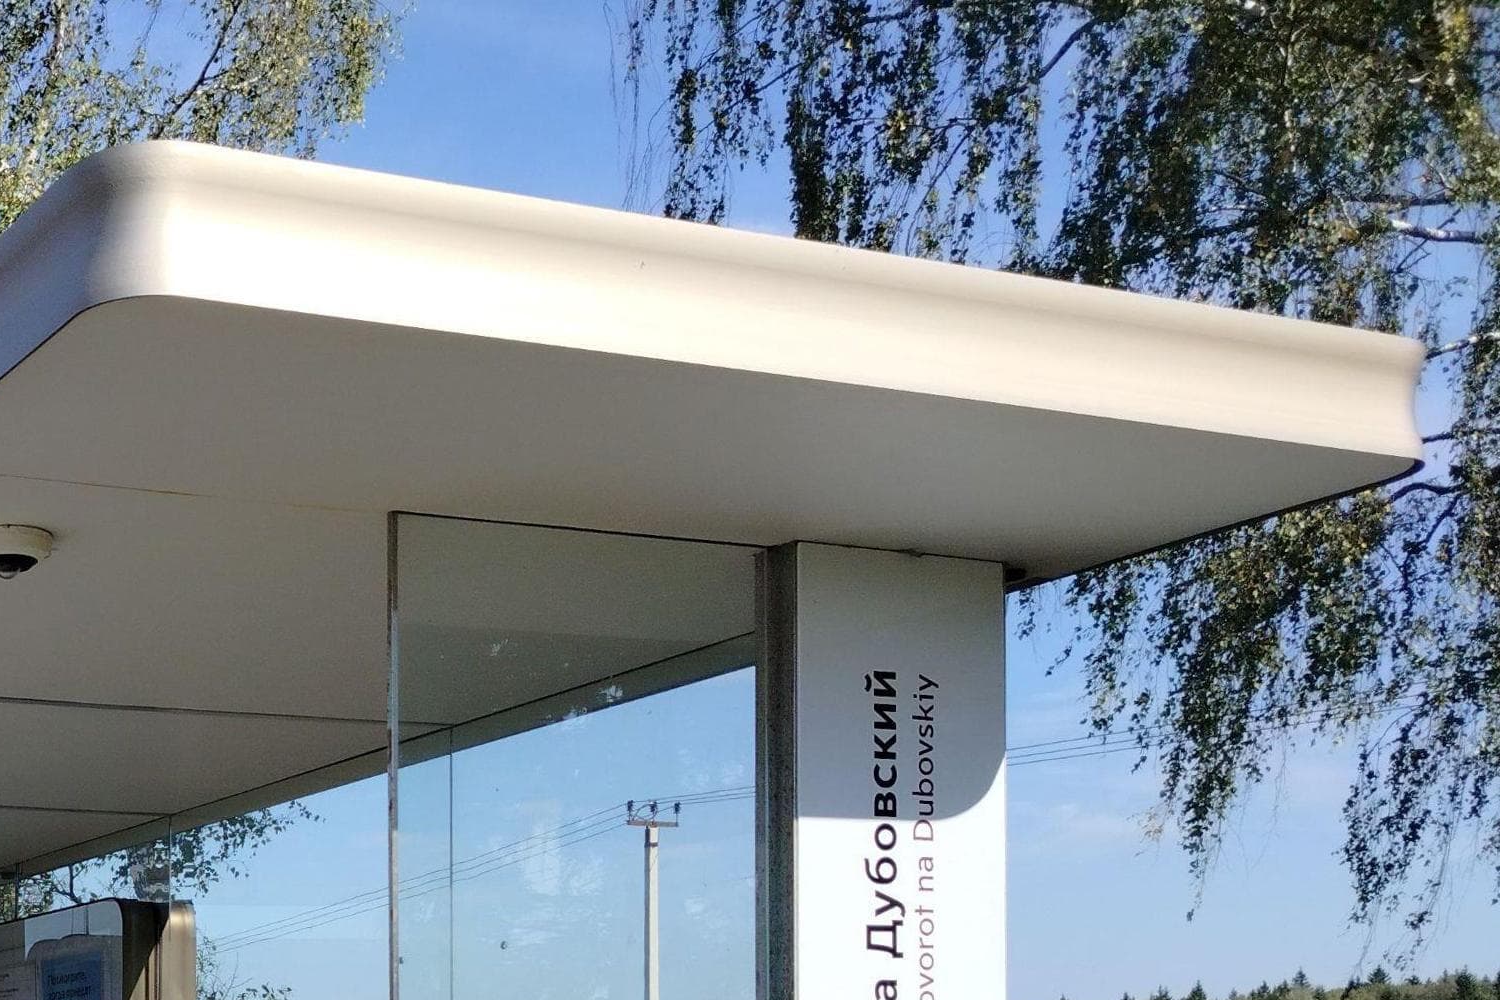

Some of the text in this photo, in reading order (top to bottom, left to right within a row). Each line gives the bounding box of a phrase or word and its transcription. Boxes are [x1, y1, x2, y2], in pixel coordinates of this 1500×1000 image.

[864, 670, 906, 959] Дубовский
[911, 673, 939, 842] Dubovskiy
[918, 856, 934, 892] na
